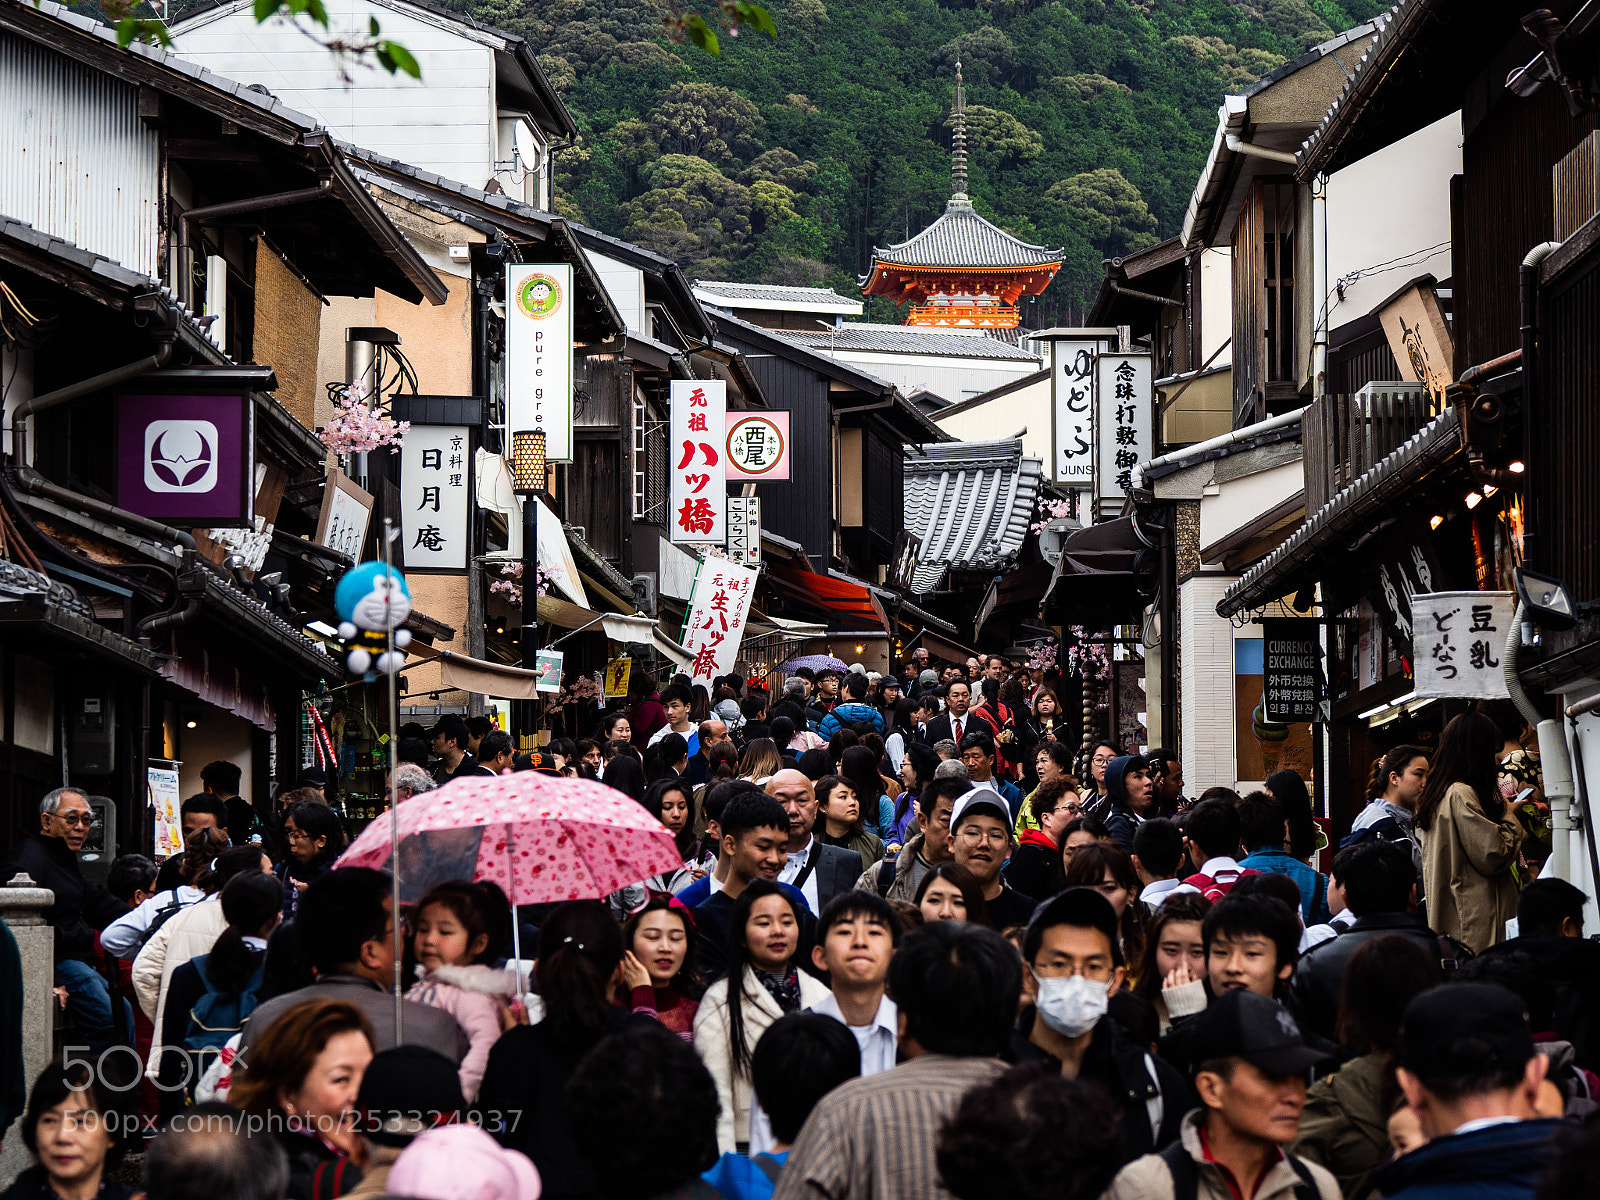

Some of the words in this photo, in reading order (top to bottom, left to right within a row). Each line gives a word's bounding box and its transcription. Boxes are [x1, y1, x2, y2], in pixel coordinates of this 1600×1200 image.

[535, 331, 543, 377] pure
[449, 434, 463, 487] 京料理
[743, 426, 766, 466] 西尾
[766, 435, 776, 456] 本家
[413, 449, 447, 552] 日月庵
[1269, 640, 1314, 653] CURRENCY
[1432, 608, 1460, 679] どーなつ
[1469, 604, 1499, 669] 豆乳
[1269, 655, 1314, 668] EXCHANGE
[1269, 703, 1289, 714] 외화
